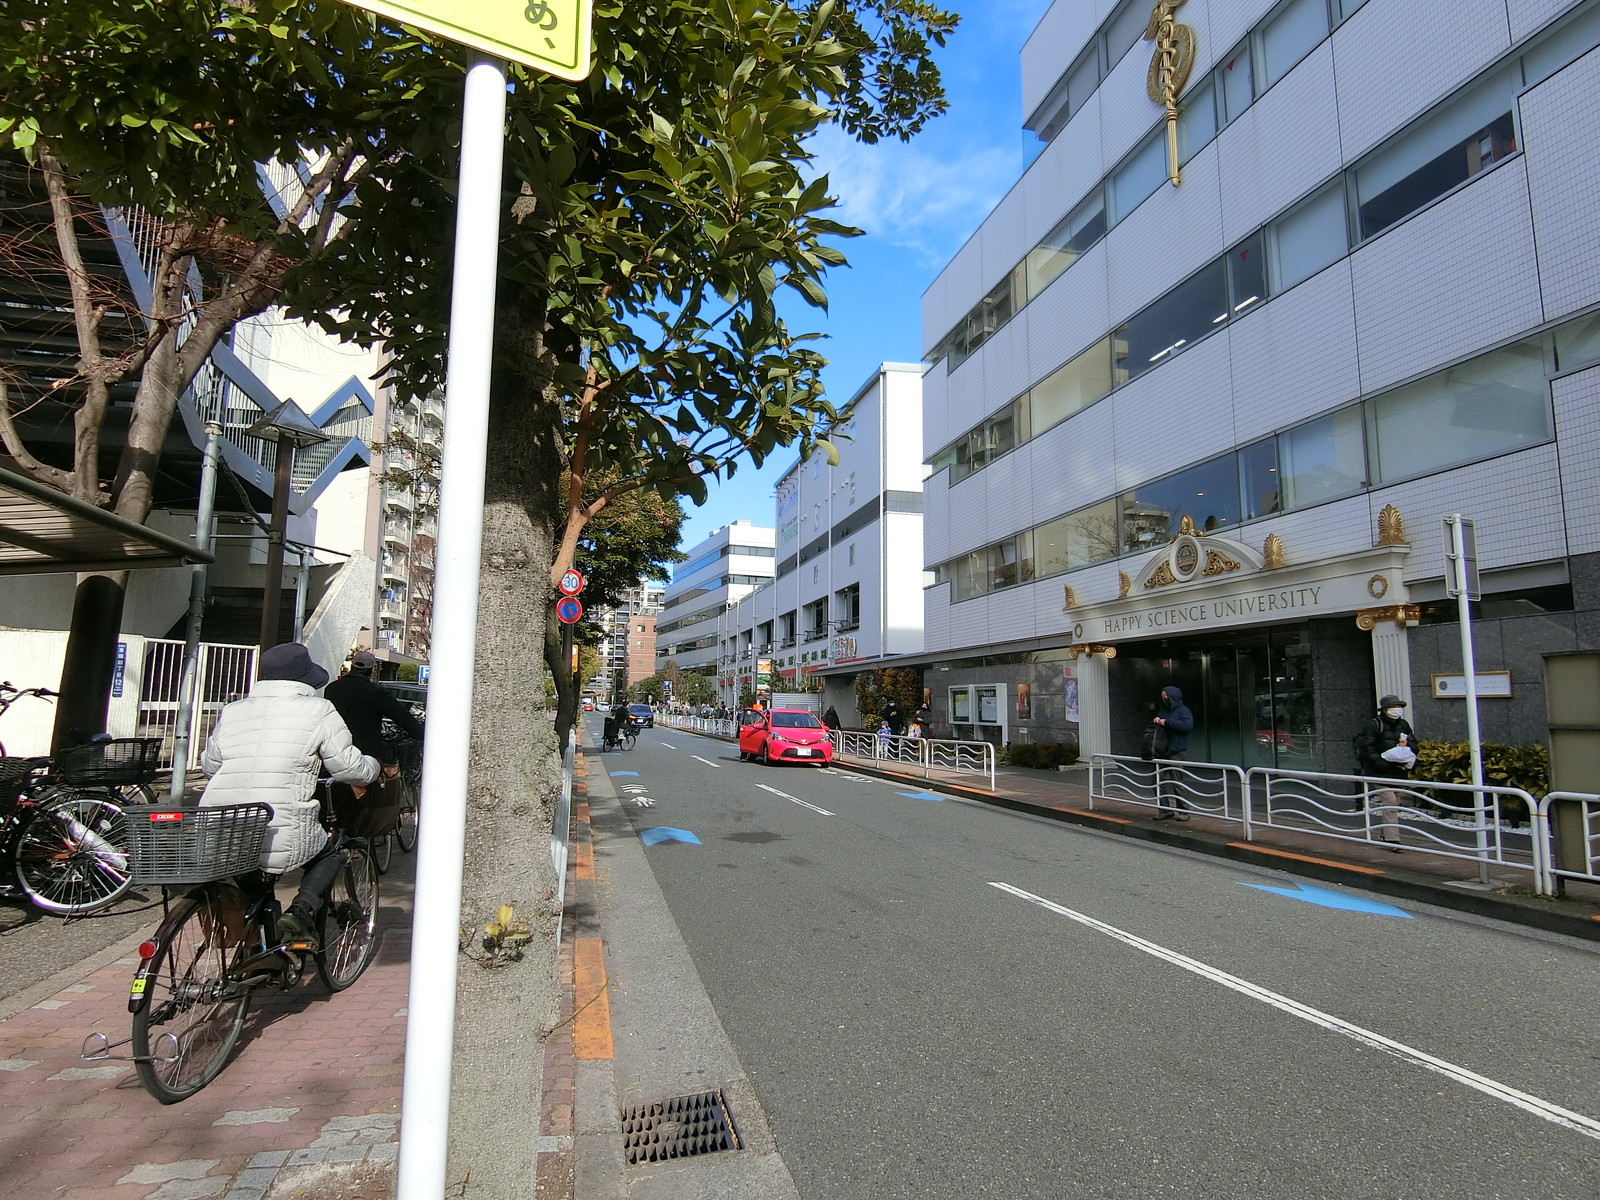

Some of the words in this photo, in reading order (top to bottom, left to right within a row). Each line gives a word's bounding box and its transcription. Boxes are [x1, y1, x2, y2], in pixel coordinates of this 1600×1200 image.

[564, 577, 578, 588] 30
[1104, 615, 1142, 633] HAPPY
[1148, 605, 1206, 627] SCIENCE
[1214, 587, 1321, 618] UNIVERSITY
